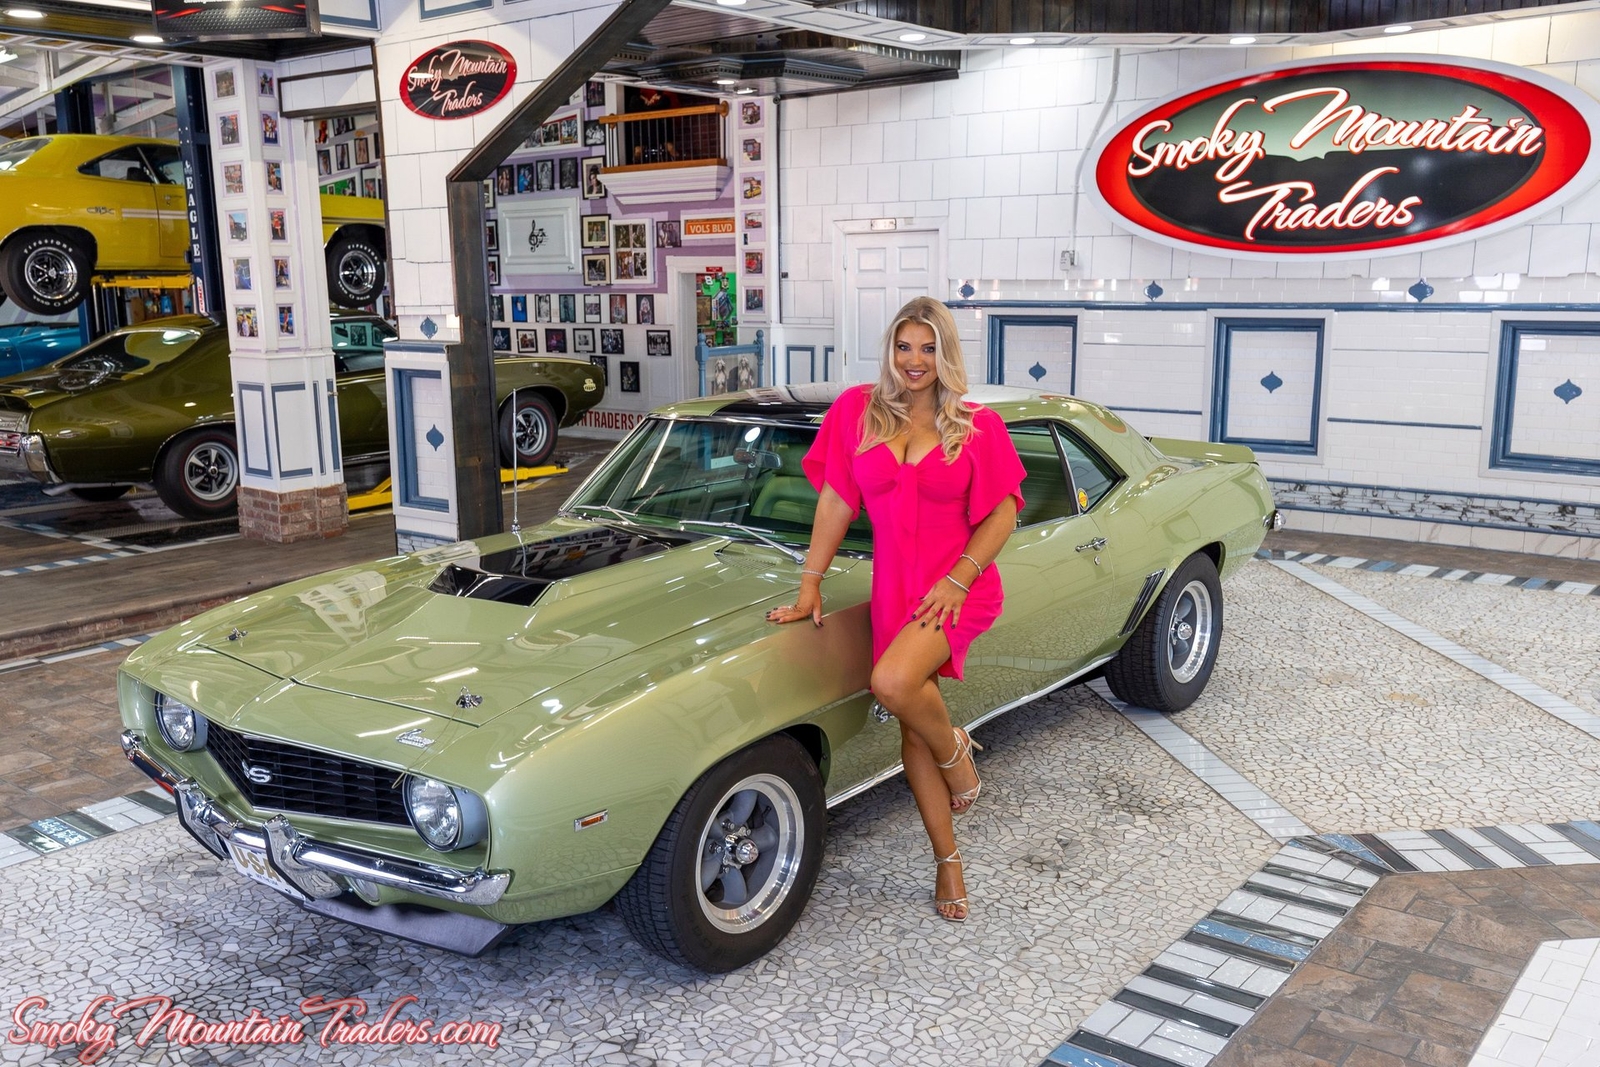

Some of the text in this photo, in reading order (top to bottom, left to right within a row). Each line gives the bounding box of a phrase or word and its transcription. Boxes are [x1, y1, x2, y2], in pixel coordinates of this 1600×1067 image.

[440, 48, 508, 76] Mountain
[432, 80, 484, 117] Traders
[1127, 86, 1546, 184] Smoky Mountain
[186, 176, 201, 257] EAGLE
[690, 224, 733, 233] VOLS BLVD
[1218, 165, 1422, 242] Traders
